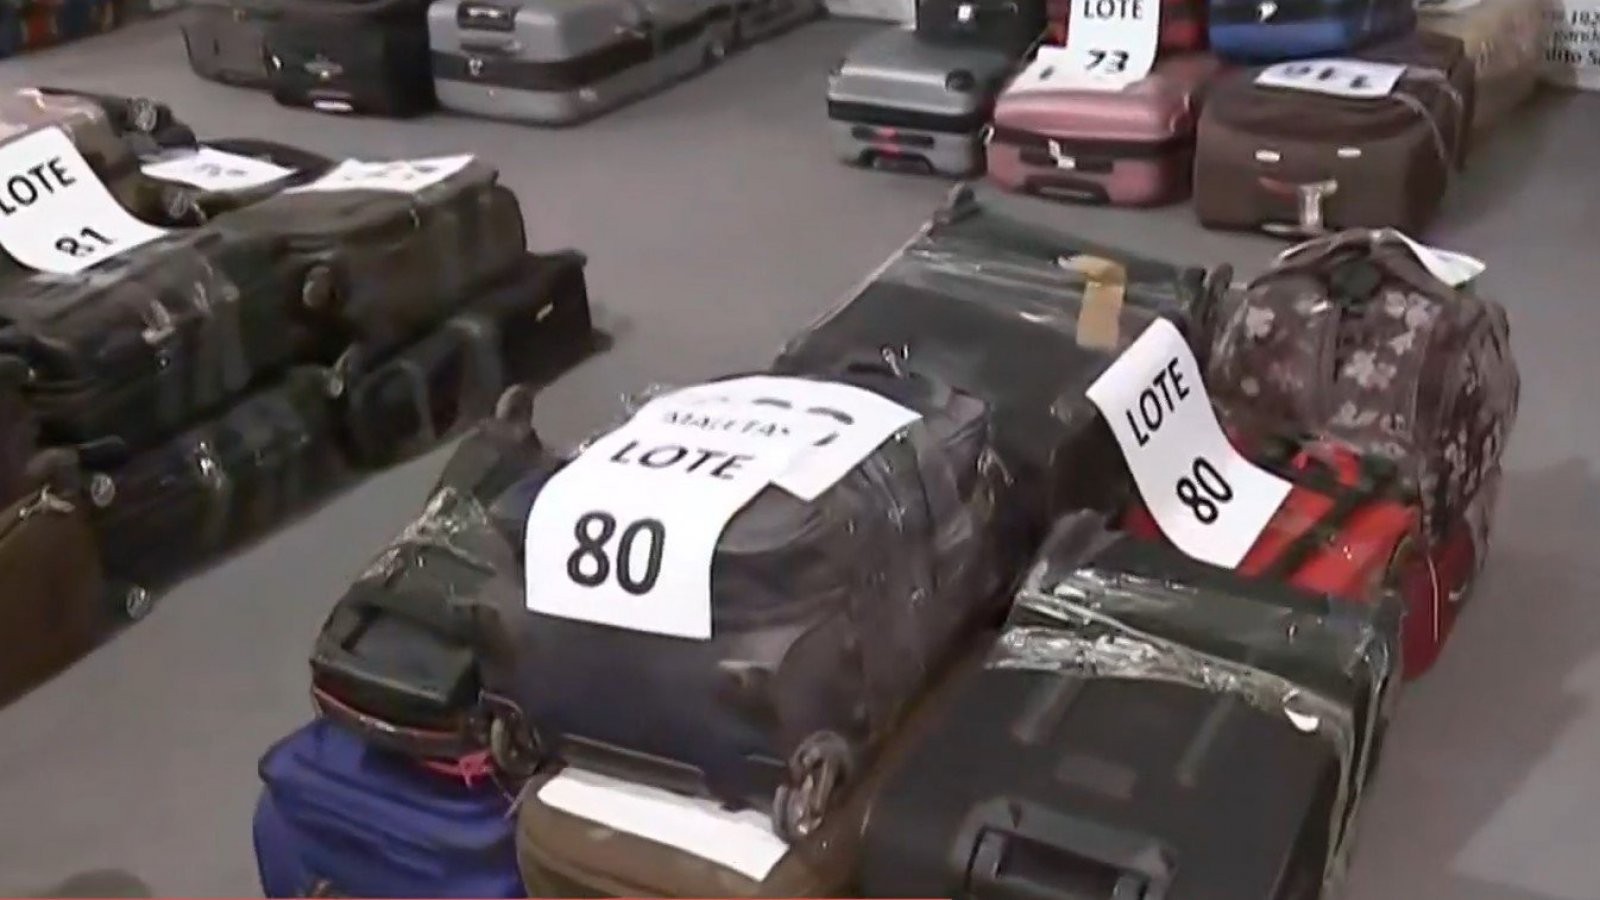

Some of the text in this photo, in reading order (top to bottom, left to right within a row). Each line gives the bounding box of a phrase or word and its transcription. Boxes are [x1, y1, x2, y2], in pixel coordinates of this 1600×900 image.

[1083, 0, 1143, 20] LOTE
[55, 226, 116, 257] 81
[1125, 356, 1191, 448] LOTE
[611, 440, 756, 480] LOTE
[1175, 455, 1234, 526] 80
[566, 510, 666, 596] 80
